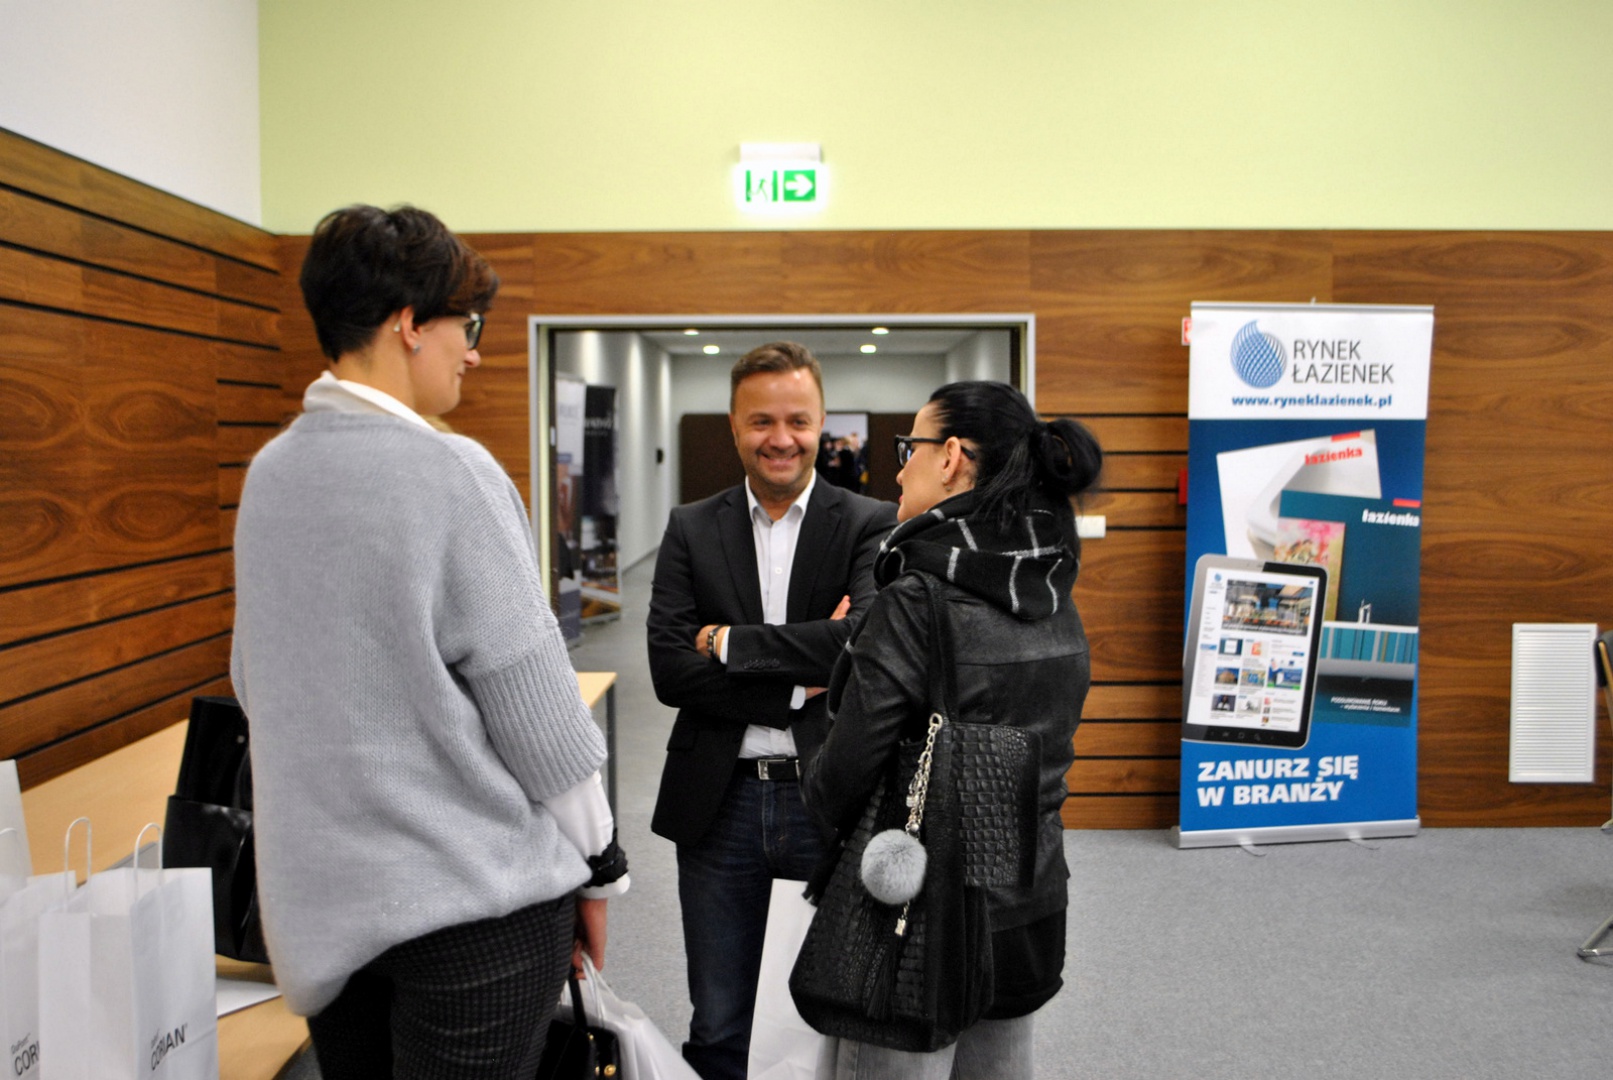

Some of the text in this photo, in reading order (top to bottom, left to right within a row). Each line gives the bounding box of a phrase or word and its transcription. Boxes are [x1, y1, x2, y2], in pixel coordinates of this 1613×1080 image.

[1293, 339, 1361, 360] RYNEK
[1292, 364, 1395, 384] ŁAZIENEK
[1232, 394, 1392, 409] www.ryneklazienek.pl
[1198, 755, 1359, 782] ZANURZ SIĘ
[1197, 777, 1344, 807] W BRANŻY
